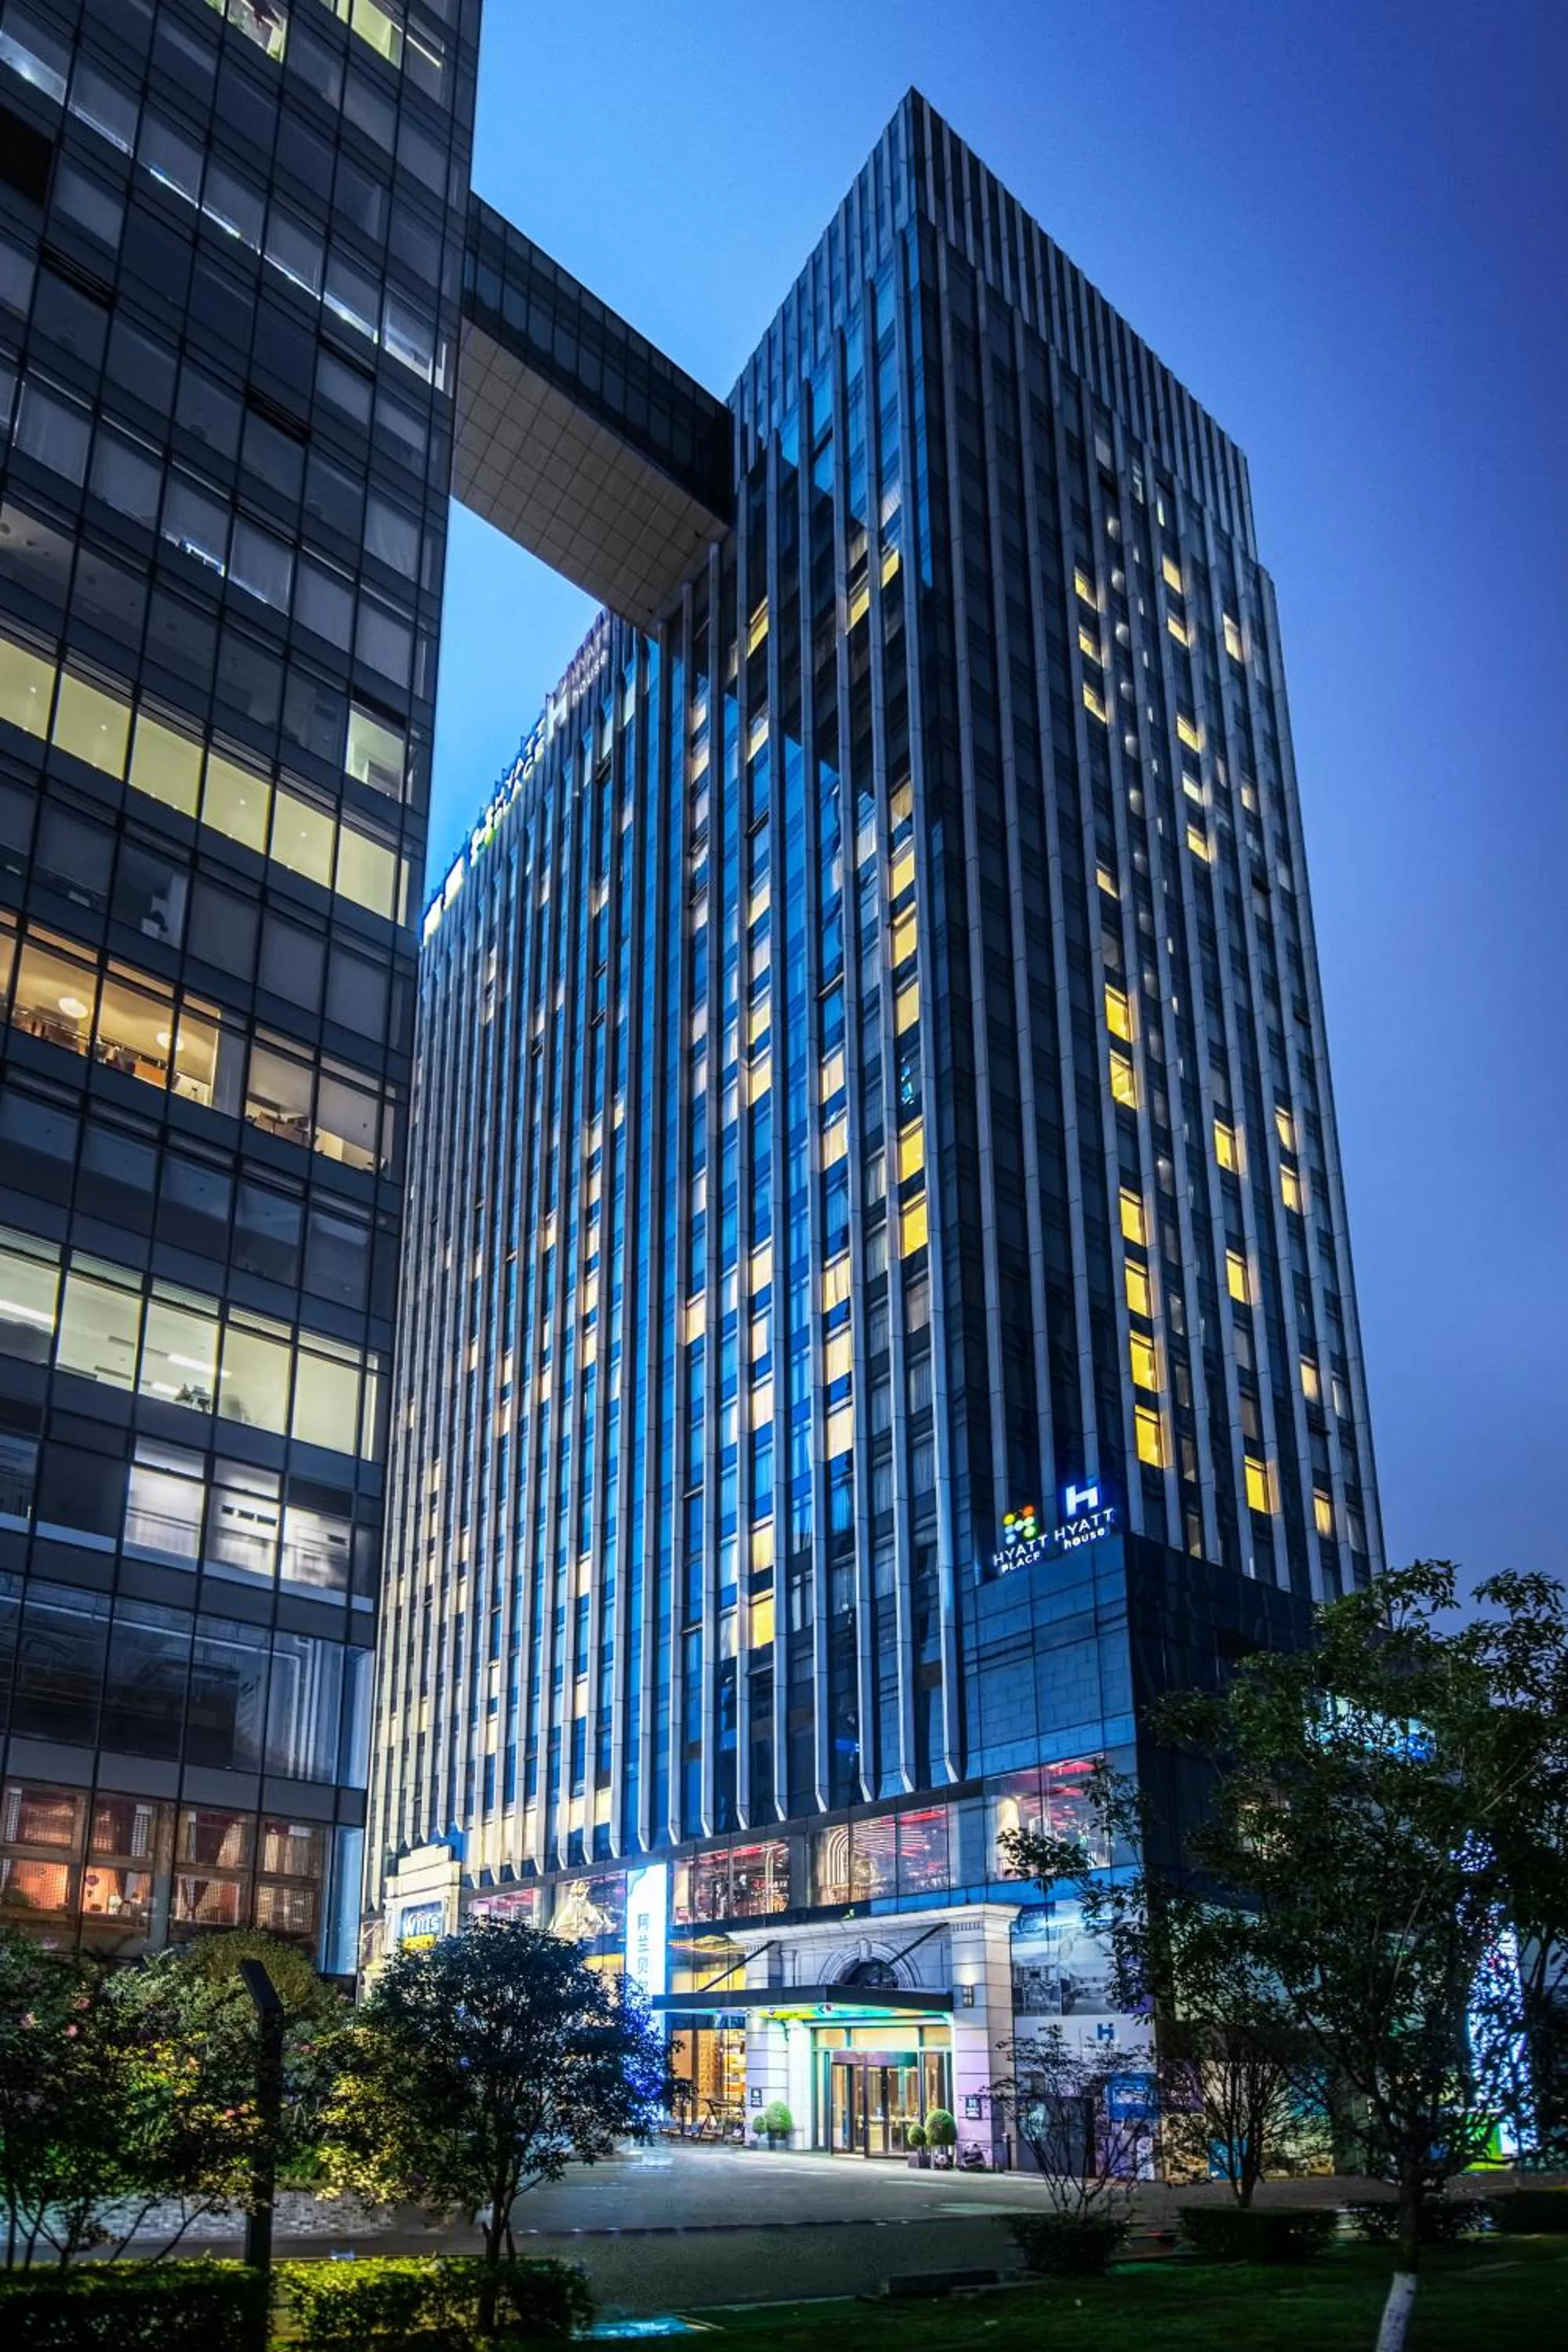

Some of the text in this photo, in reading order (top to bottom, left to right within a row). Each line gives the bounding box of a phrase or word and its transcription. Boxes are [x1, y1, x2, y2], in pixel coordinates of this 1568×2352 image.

[1065, 1485, 1099, 1517] H
[1054, 1508, 1114, 1541] HYATT
[1064, 1527, 1105, 1549] house
[993, 1534, 1048, 1566] HYATT
[1000, 1551, 1041, 1573] PLACE
